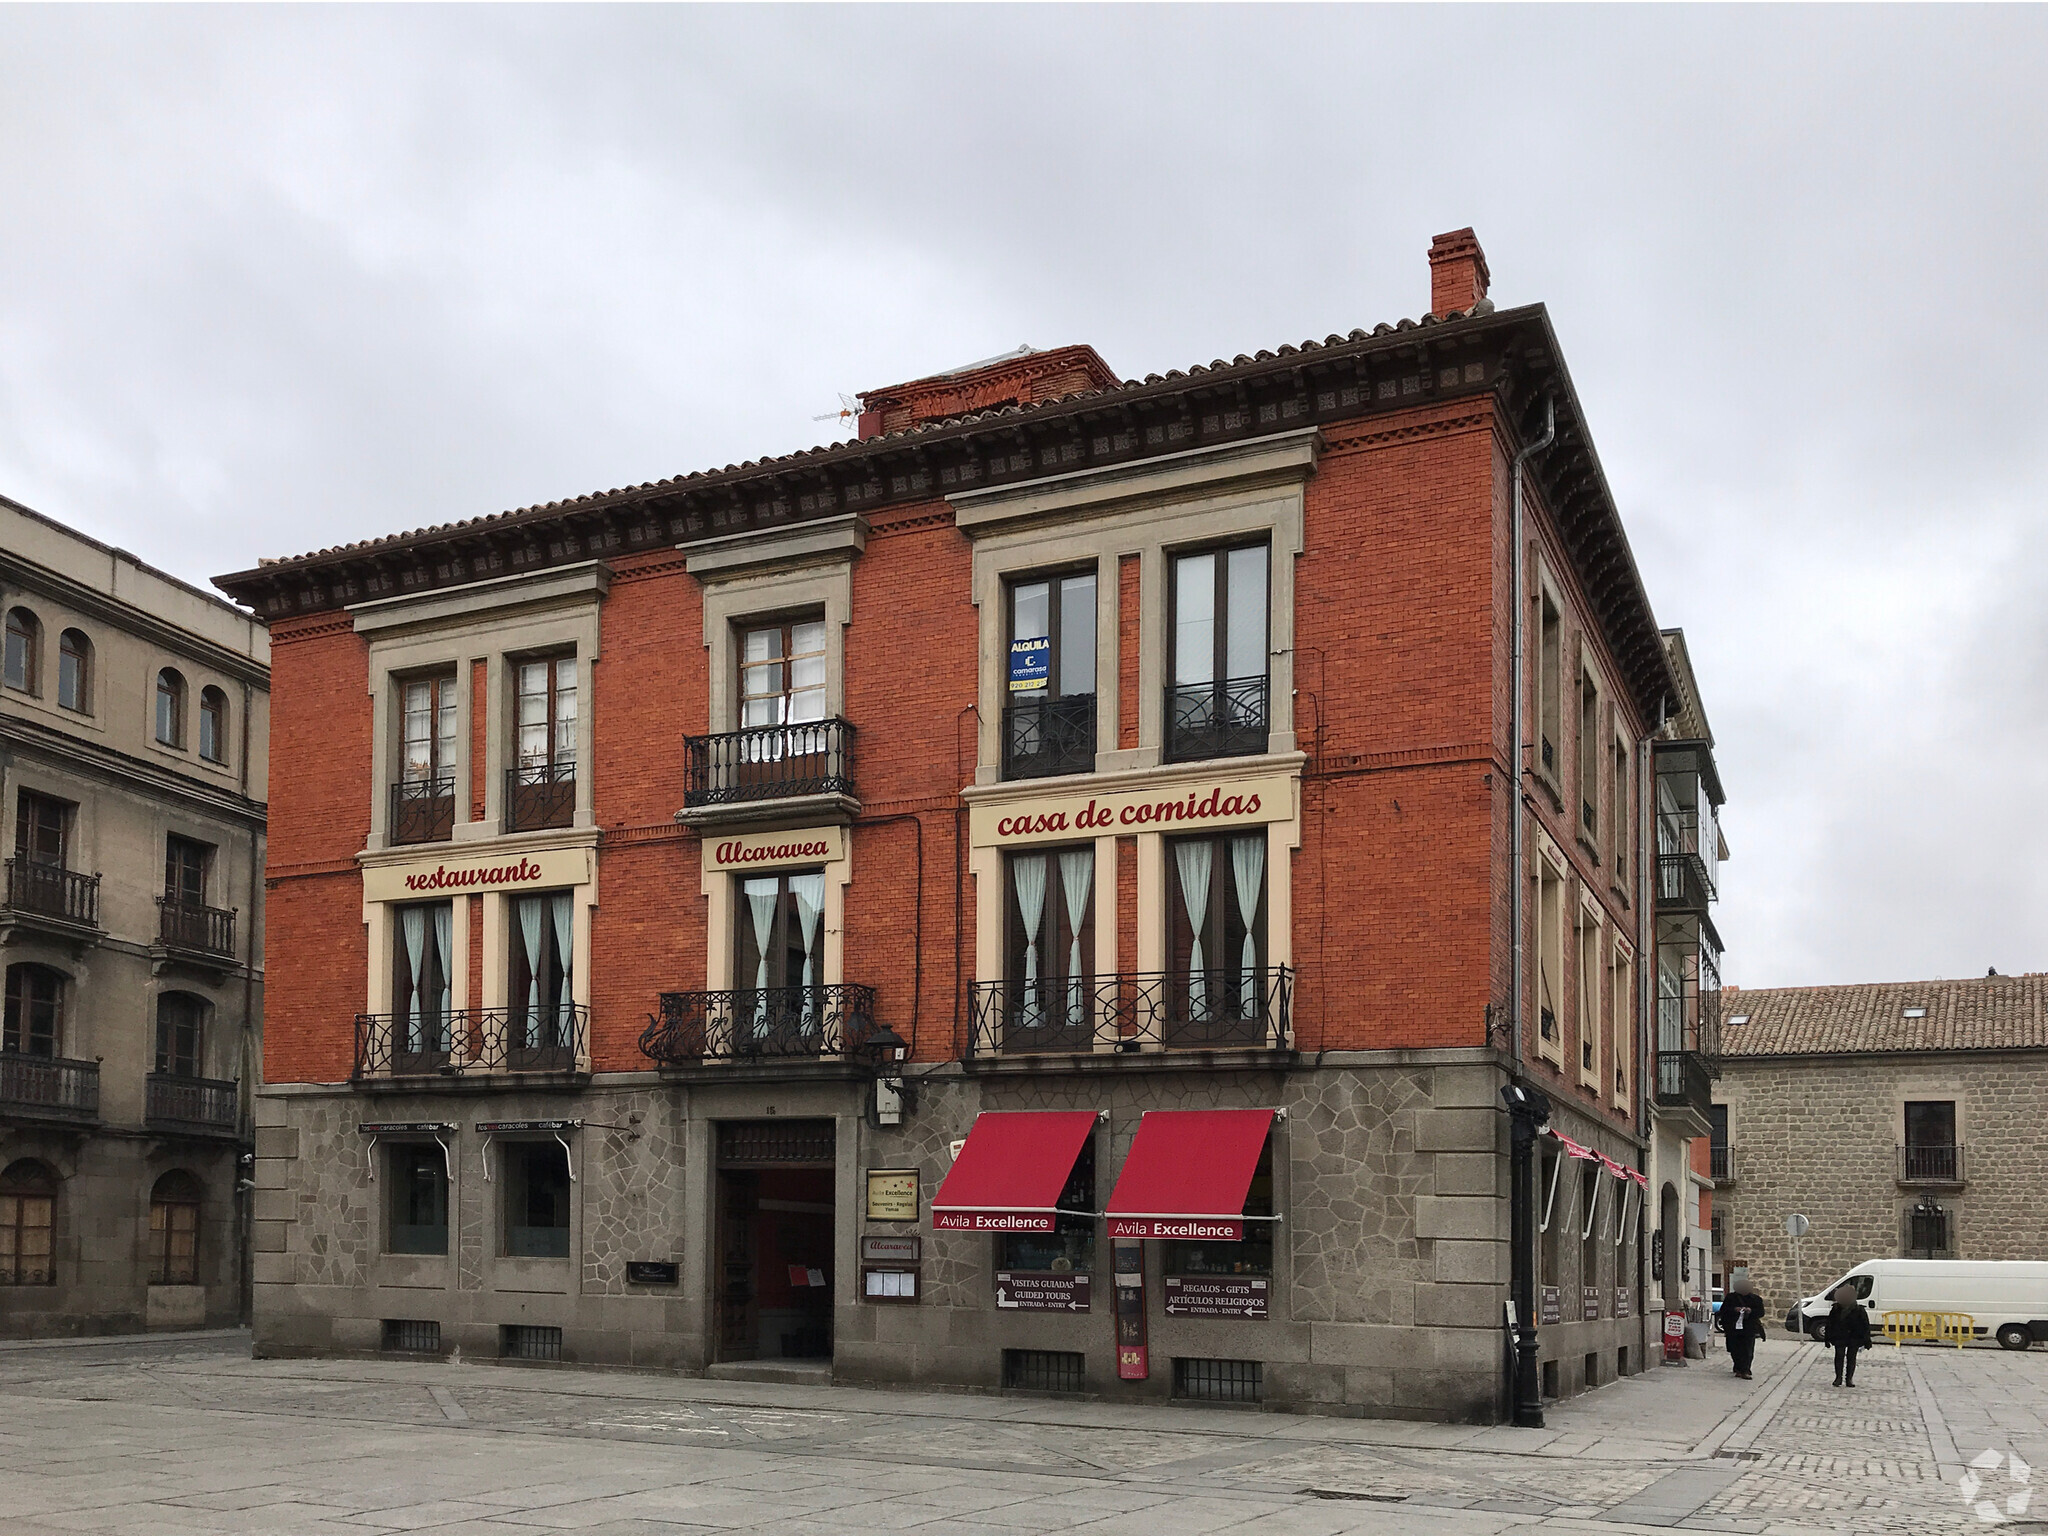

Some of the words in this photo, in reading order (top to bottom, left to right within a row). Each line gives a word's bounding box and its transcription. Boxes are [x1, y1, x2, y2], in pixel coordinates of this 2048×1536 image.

[1011, 639, 1049, 652] ALQUILA
[998, 811, 1069, 836] casa
[1075, 800, 1114, 829] de
[1120, 787, 1261, 824] comidas
[716, 841, 829, 864] Alcaravea
[405, 857, 542, 891] restaurante
[940, 1215, 970, 1227] Avila
[976, 1216, 1048, 1228] Excellence
[1115, 1222, 1147, 1234] Avila
[1154, 1223, 1234, 1236] Excellence
[870, 1241, 913, 1250] Alcaravea
[1040, 1281, 1074, 1289] GUIADAS
[1183, 1284, 1220, 1293] REGALOS
[1226, 1286, 1250, 1294] GIFTS
[1015, 1291, 1044, 1299] GUIDED
[1045, 1292, 1071, 1300] TOURS
[1168, 1294, 1214, 1305] ARTÍCULOS
[1215, 1297, 1265, 1306] RELIGIOSOS
